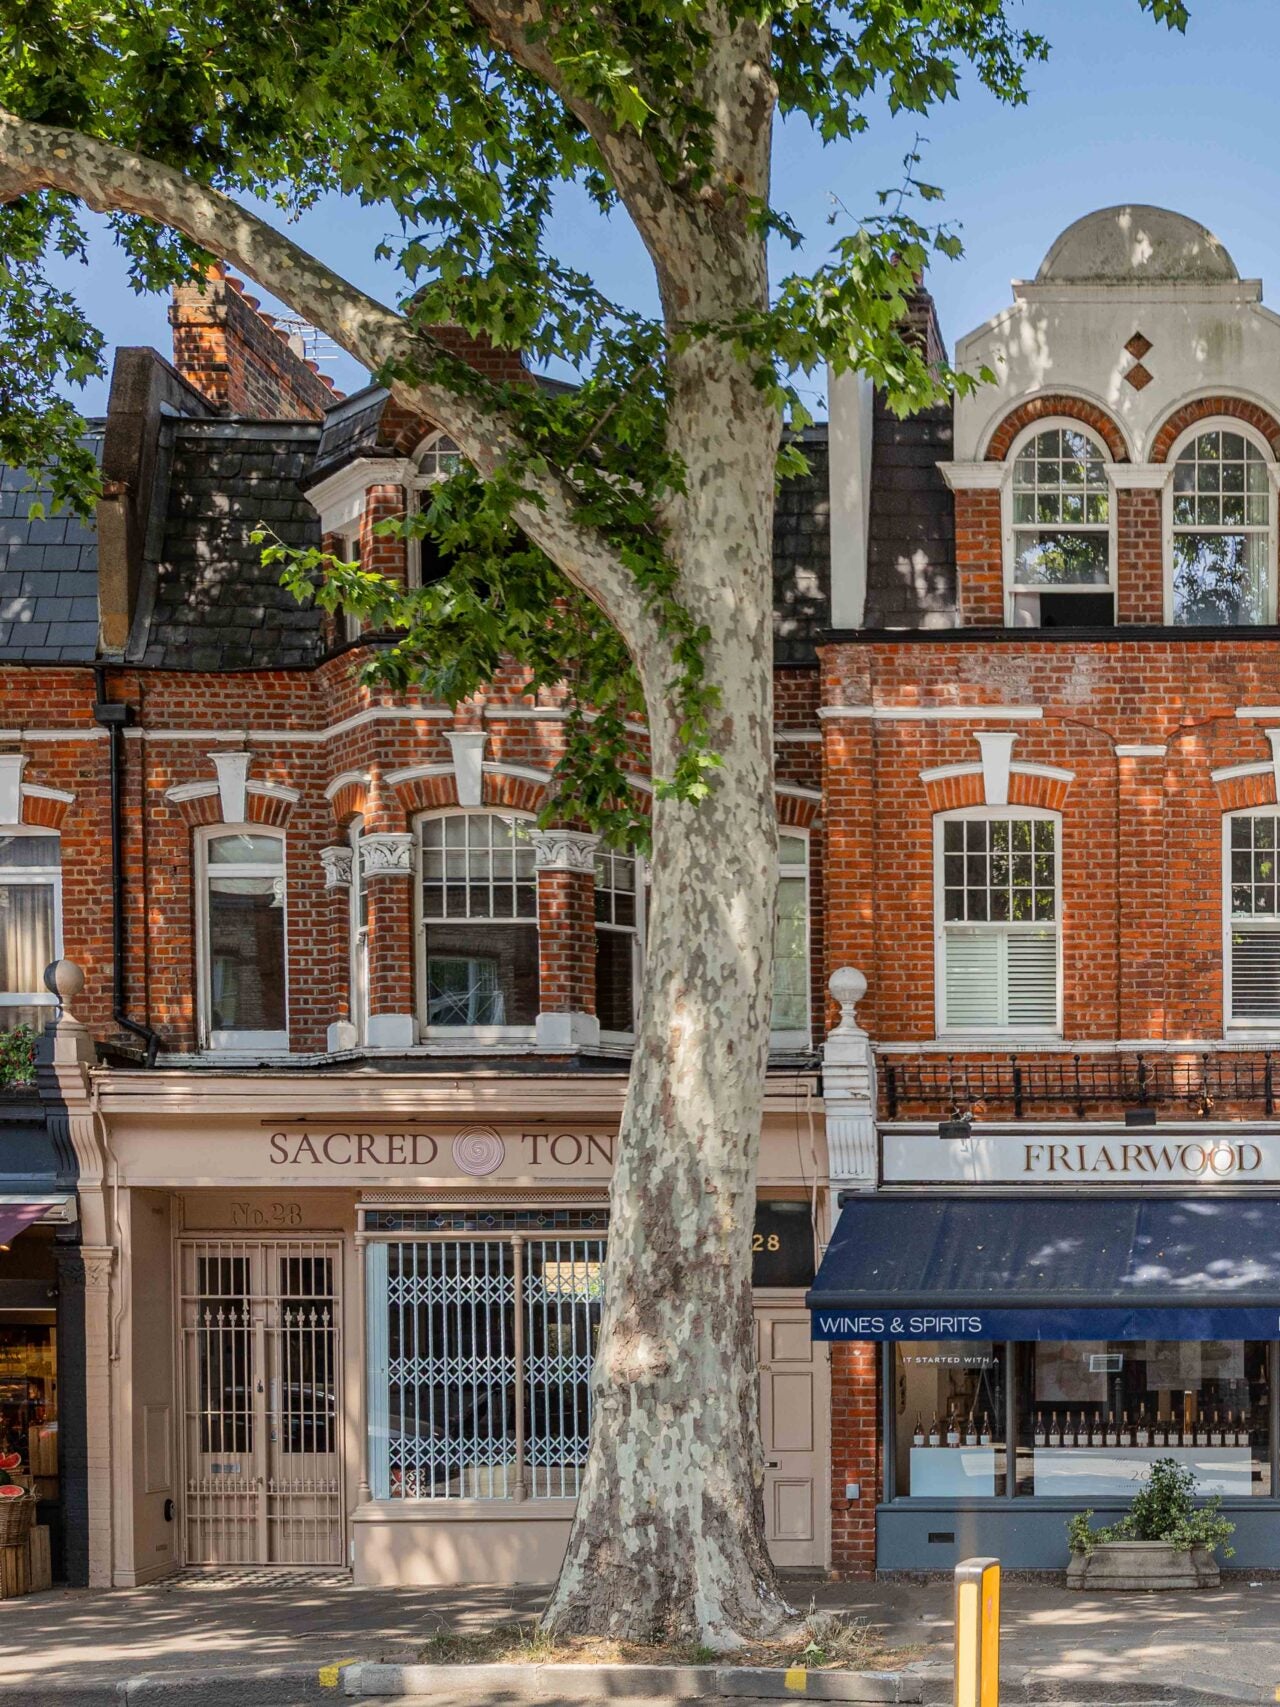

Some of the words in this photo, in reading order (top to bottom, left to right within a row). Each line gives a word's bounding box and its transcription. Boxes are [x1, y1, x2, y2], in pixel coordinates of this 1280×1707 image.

[269, 1132, 438, 1166] SACRED
[1023, 1143, 1263, 1173] FRIARWOOD
[752, 1233, 780, 1251] 28
[819, 1317, 885, 1334] WINES
[889, 1316, 905, 1333] &
[909, 1316, 983, 1333] SPIRITS
[902, 1356, 913, 1364] IT
[915, 1356, 960, 1364] STARTED
[963, 1356, 990, 1364] WITH
[992, 1356, 1000, 1364] A
